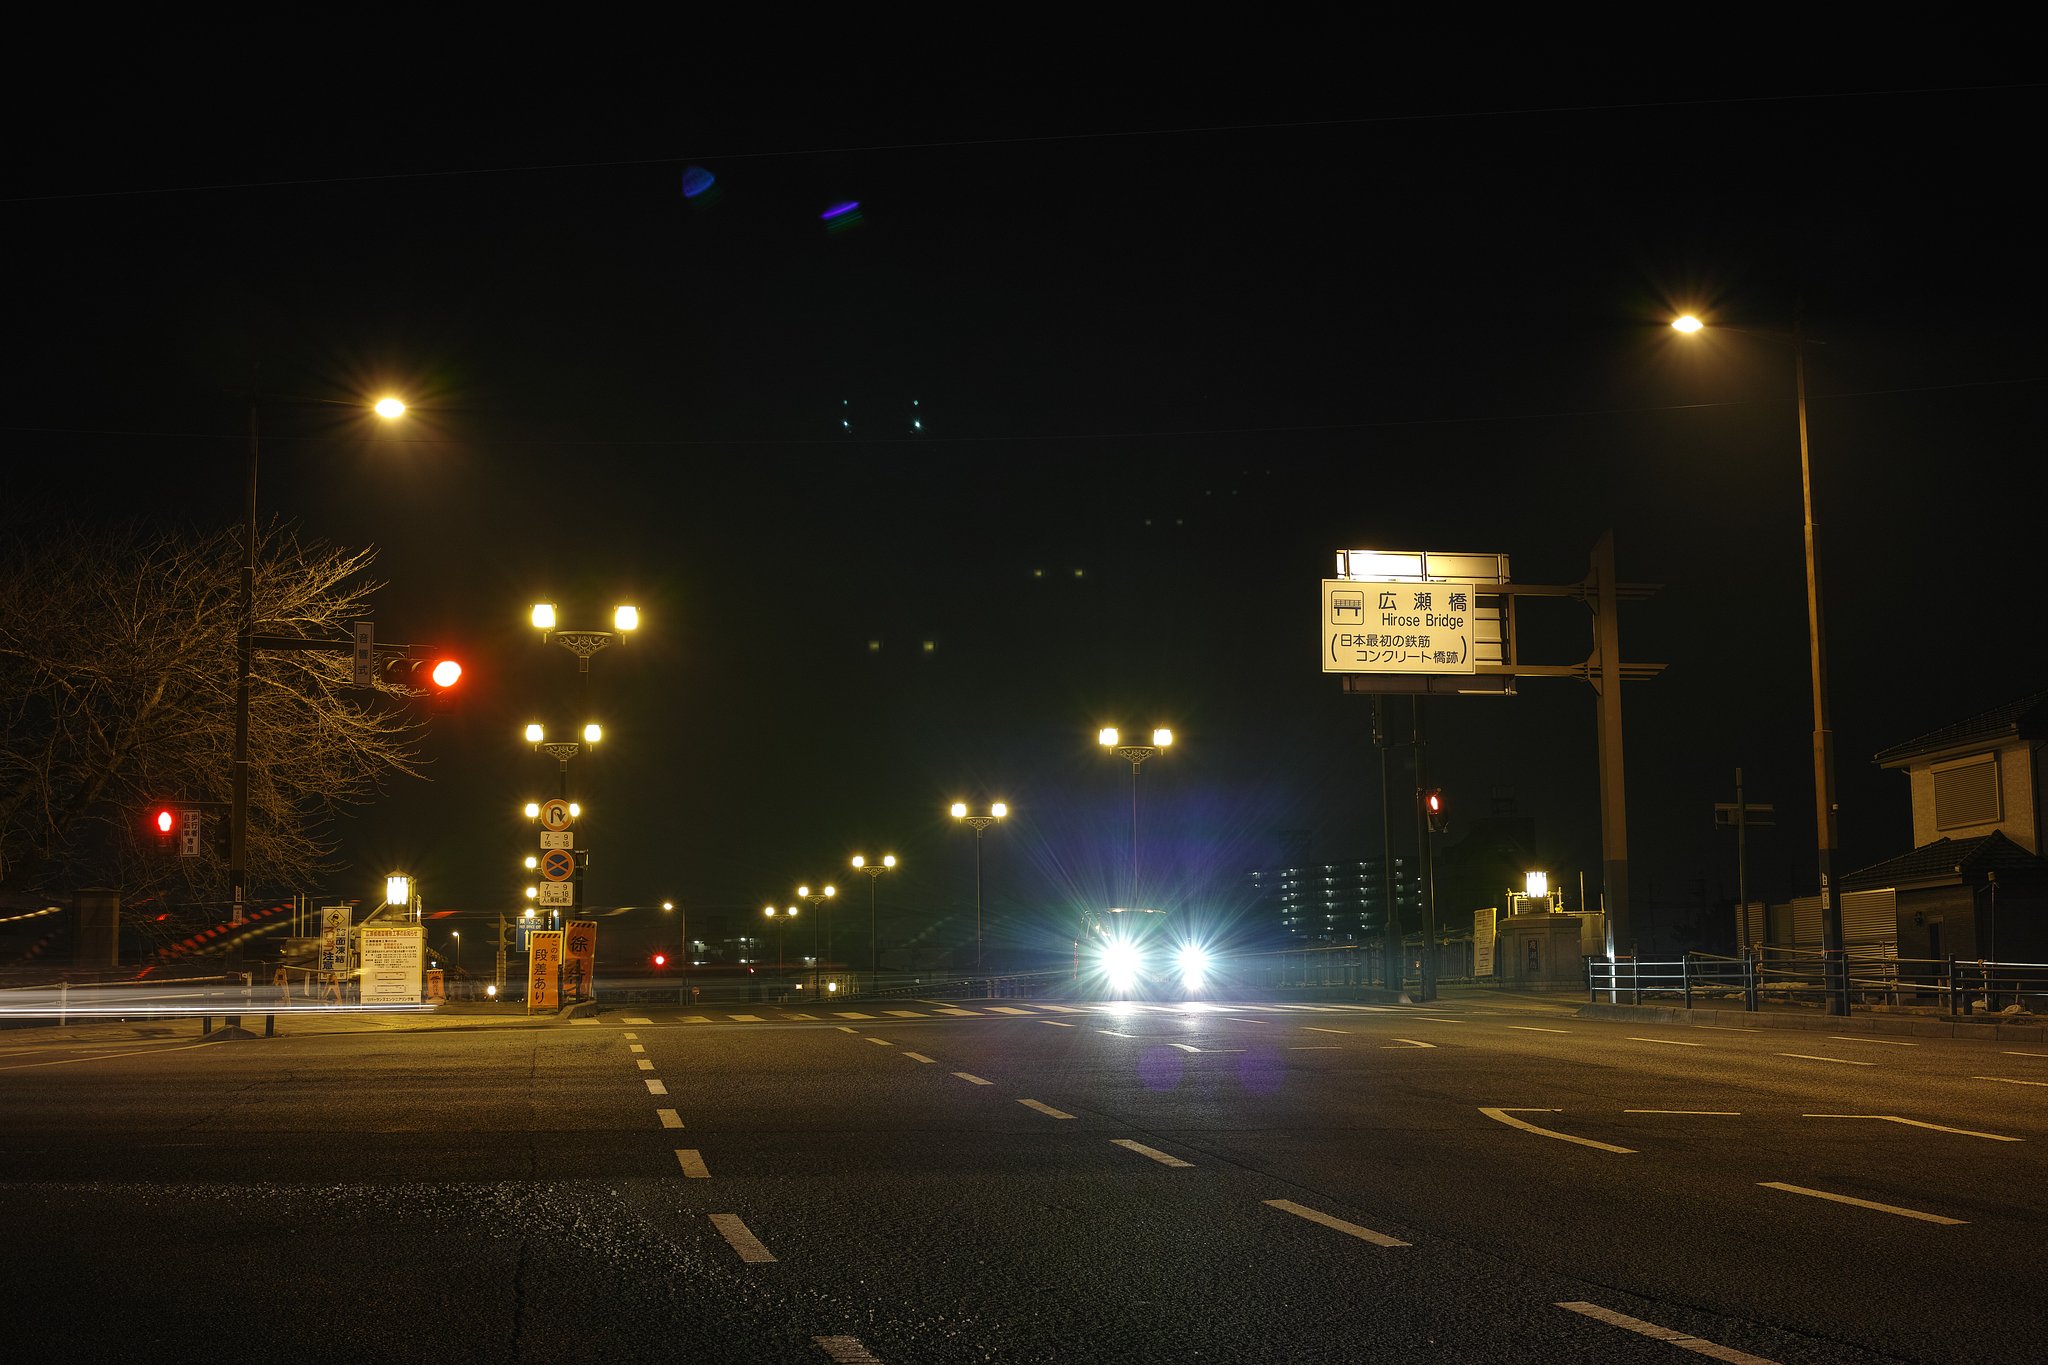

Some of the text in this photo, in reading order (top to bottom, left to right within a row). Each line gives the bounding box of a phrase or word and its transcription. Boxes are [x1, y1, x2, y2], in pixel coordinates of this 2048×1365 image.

[1378, 591, 1467, 612] 広瀬橋
[1382, 613, 1464, 630] Hirose Bridge
[550, 939, 559, 962] この先
[533, 949, 548, 1004] 段差あり
